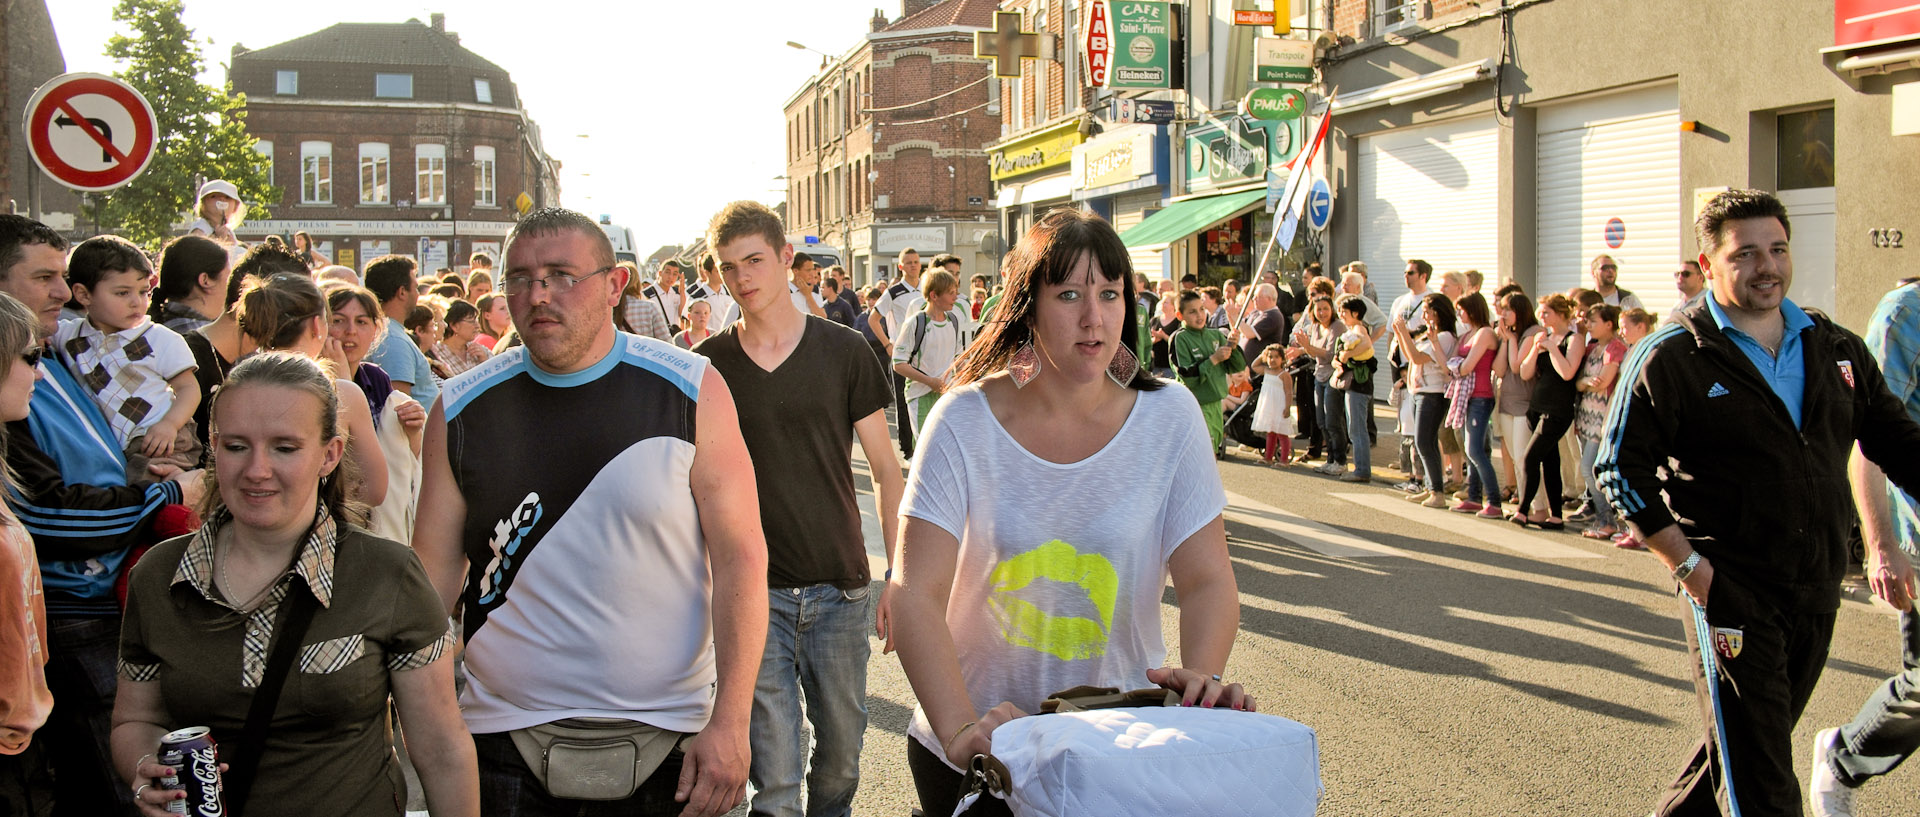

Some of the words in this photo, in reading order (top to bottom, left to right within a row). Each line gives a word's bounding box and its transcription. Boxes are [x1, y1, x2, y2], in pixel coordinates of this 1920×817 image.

[1121, 3, 1160, 18] CAFE
[1236, 12, 1254, 21] Nord
[1091, 4, 1107, 82] TABAC
[1268, 49, 1305, 61] Transpole
[1119, 70, 1160, 80] Heineken
[1284, 71, 1306, 80] Service
[652, 350, 692, 371] DESIGN
[451, 368, 492, 395] ITALIAN
[1707, 389, 1730, 398] adidas
[1719, 635, 1731, 657] RCL
